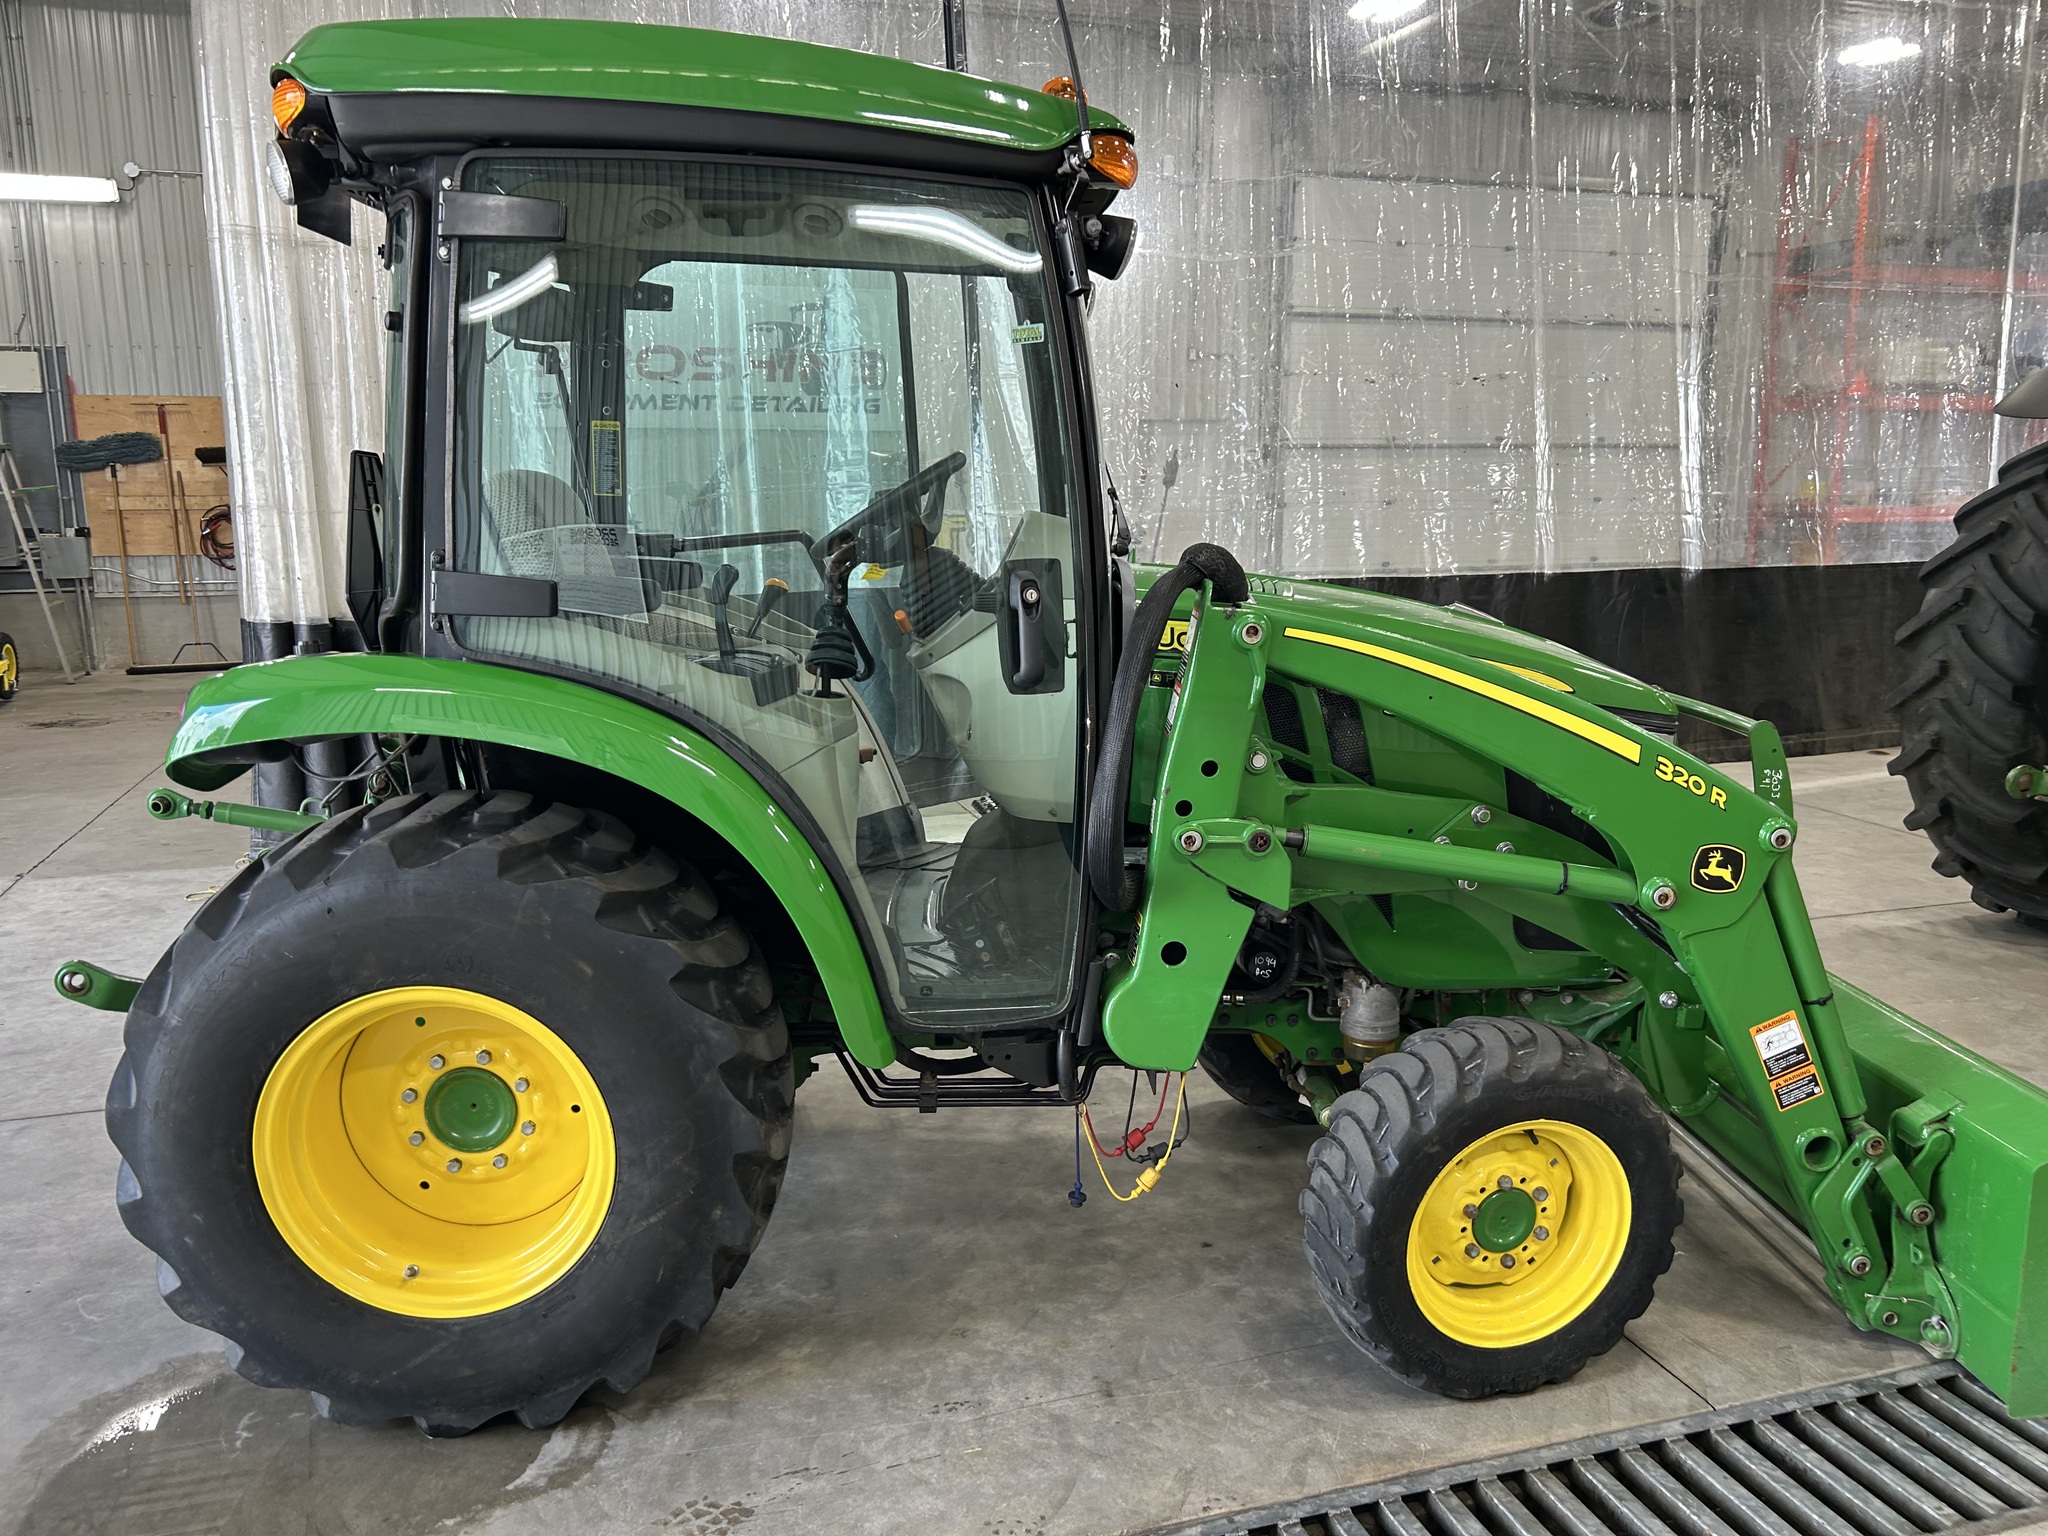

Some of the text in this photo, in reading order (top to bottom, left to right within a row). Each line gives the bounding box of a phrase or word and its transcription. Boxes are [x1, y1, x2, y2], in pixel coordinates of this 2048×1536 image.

[1654, 754, 1728, 812] 320 R
[1762, 1014, 1791, 1030] WARNING
[1783, 1068, 1812, 1085] WARNING
